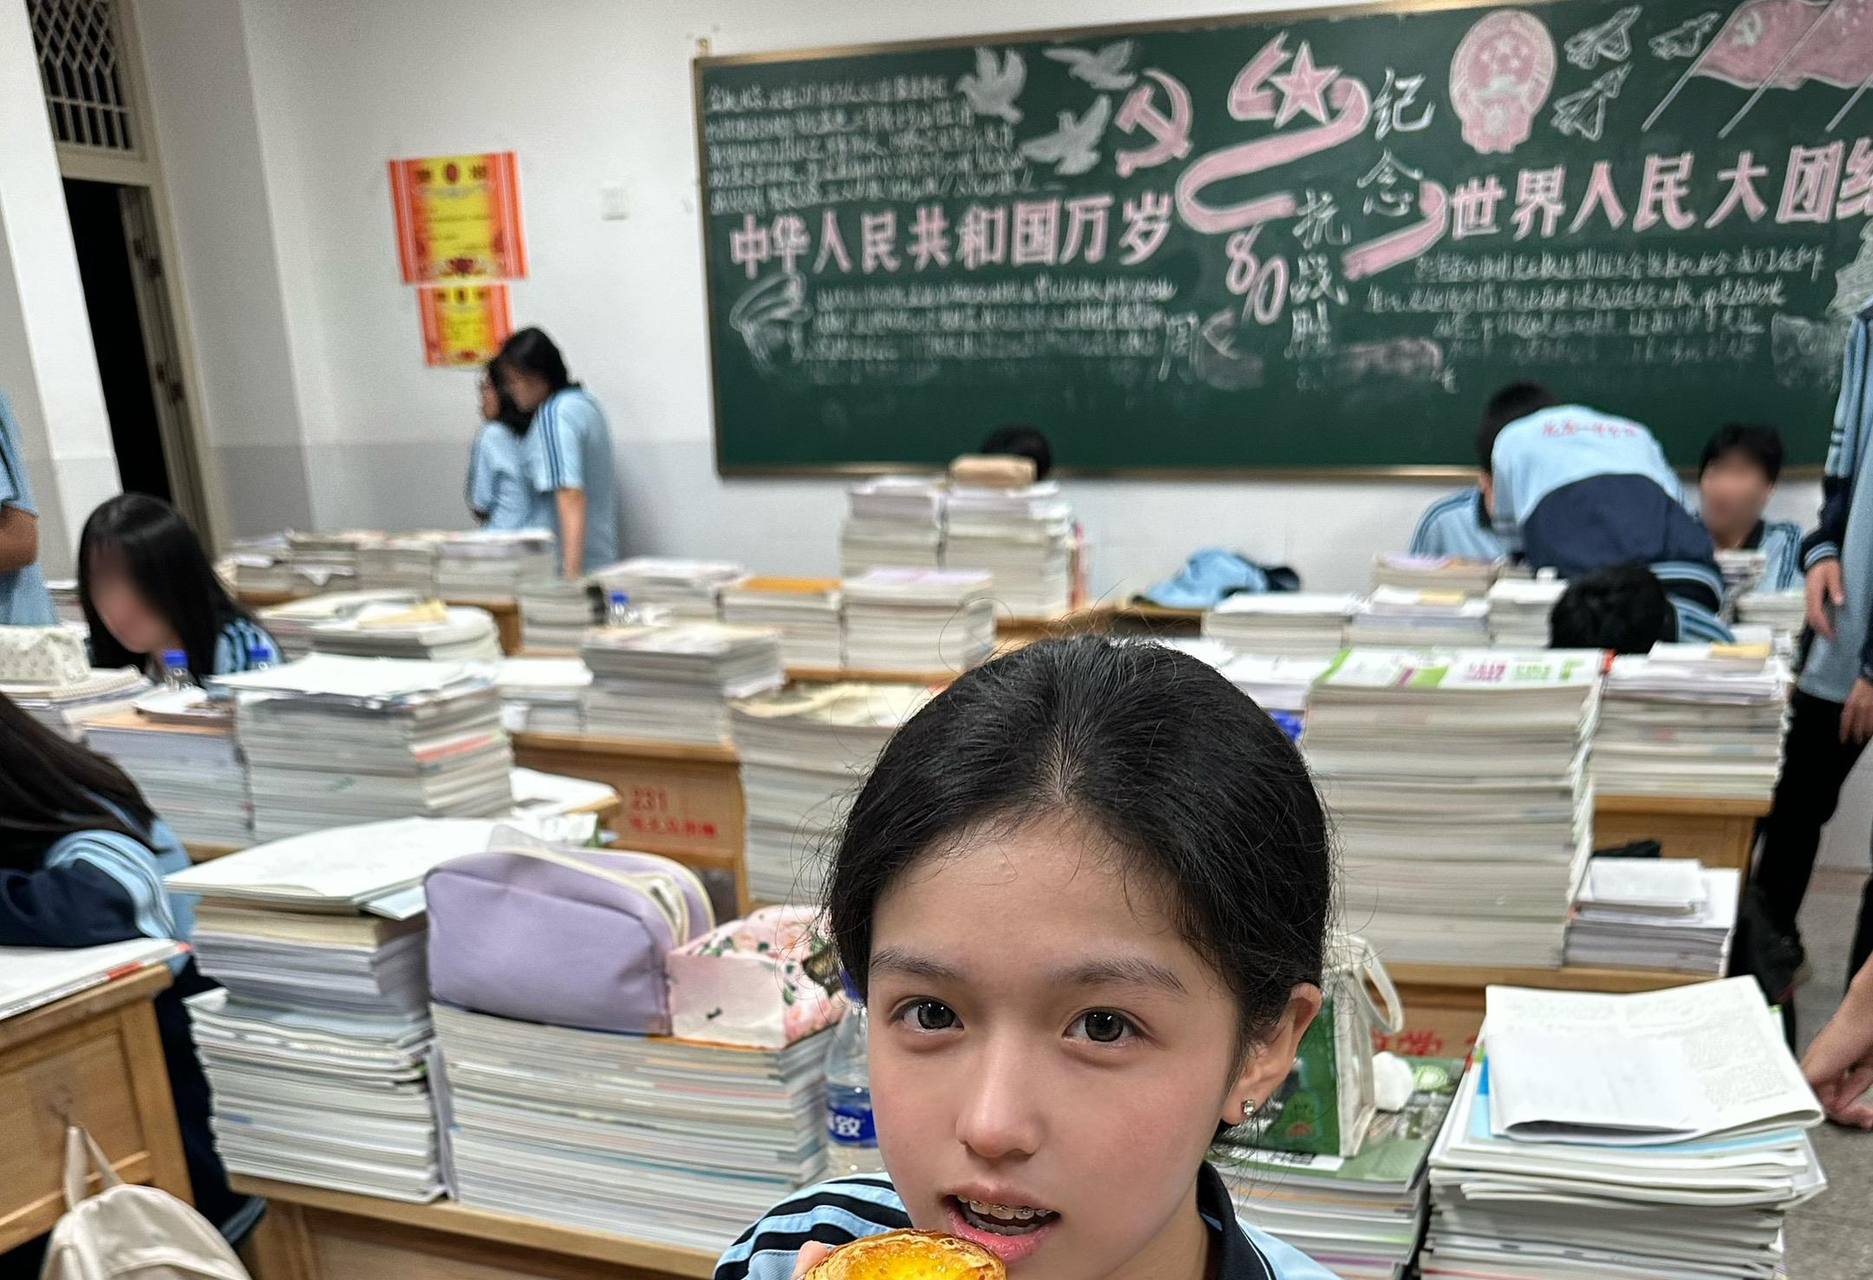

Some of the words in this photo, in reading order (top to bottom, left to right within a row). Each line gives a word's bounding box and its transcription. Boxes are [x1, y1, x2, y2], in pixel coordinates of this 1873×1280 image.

[1356, 66, 1437, 216] 纪念
[730, 190, 1173, 280] 中华人民共和国万岁
[1225, 220, 1290, 327] 80
